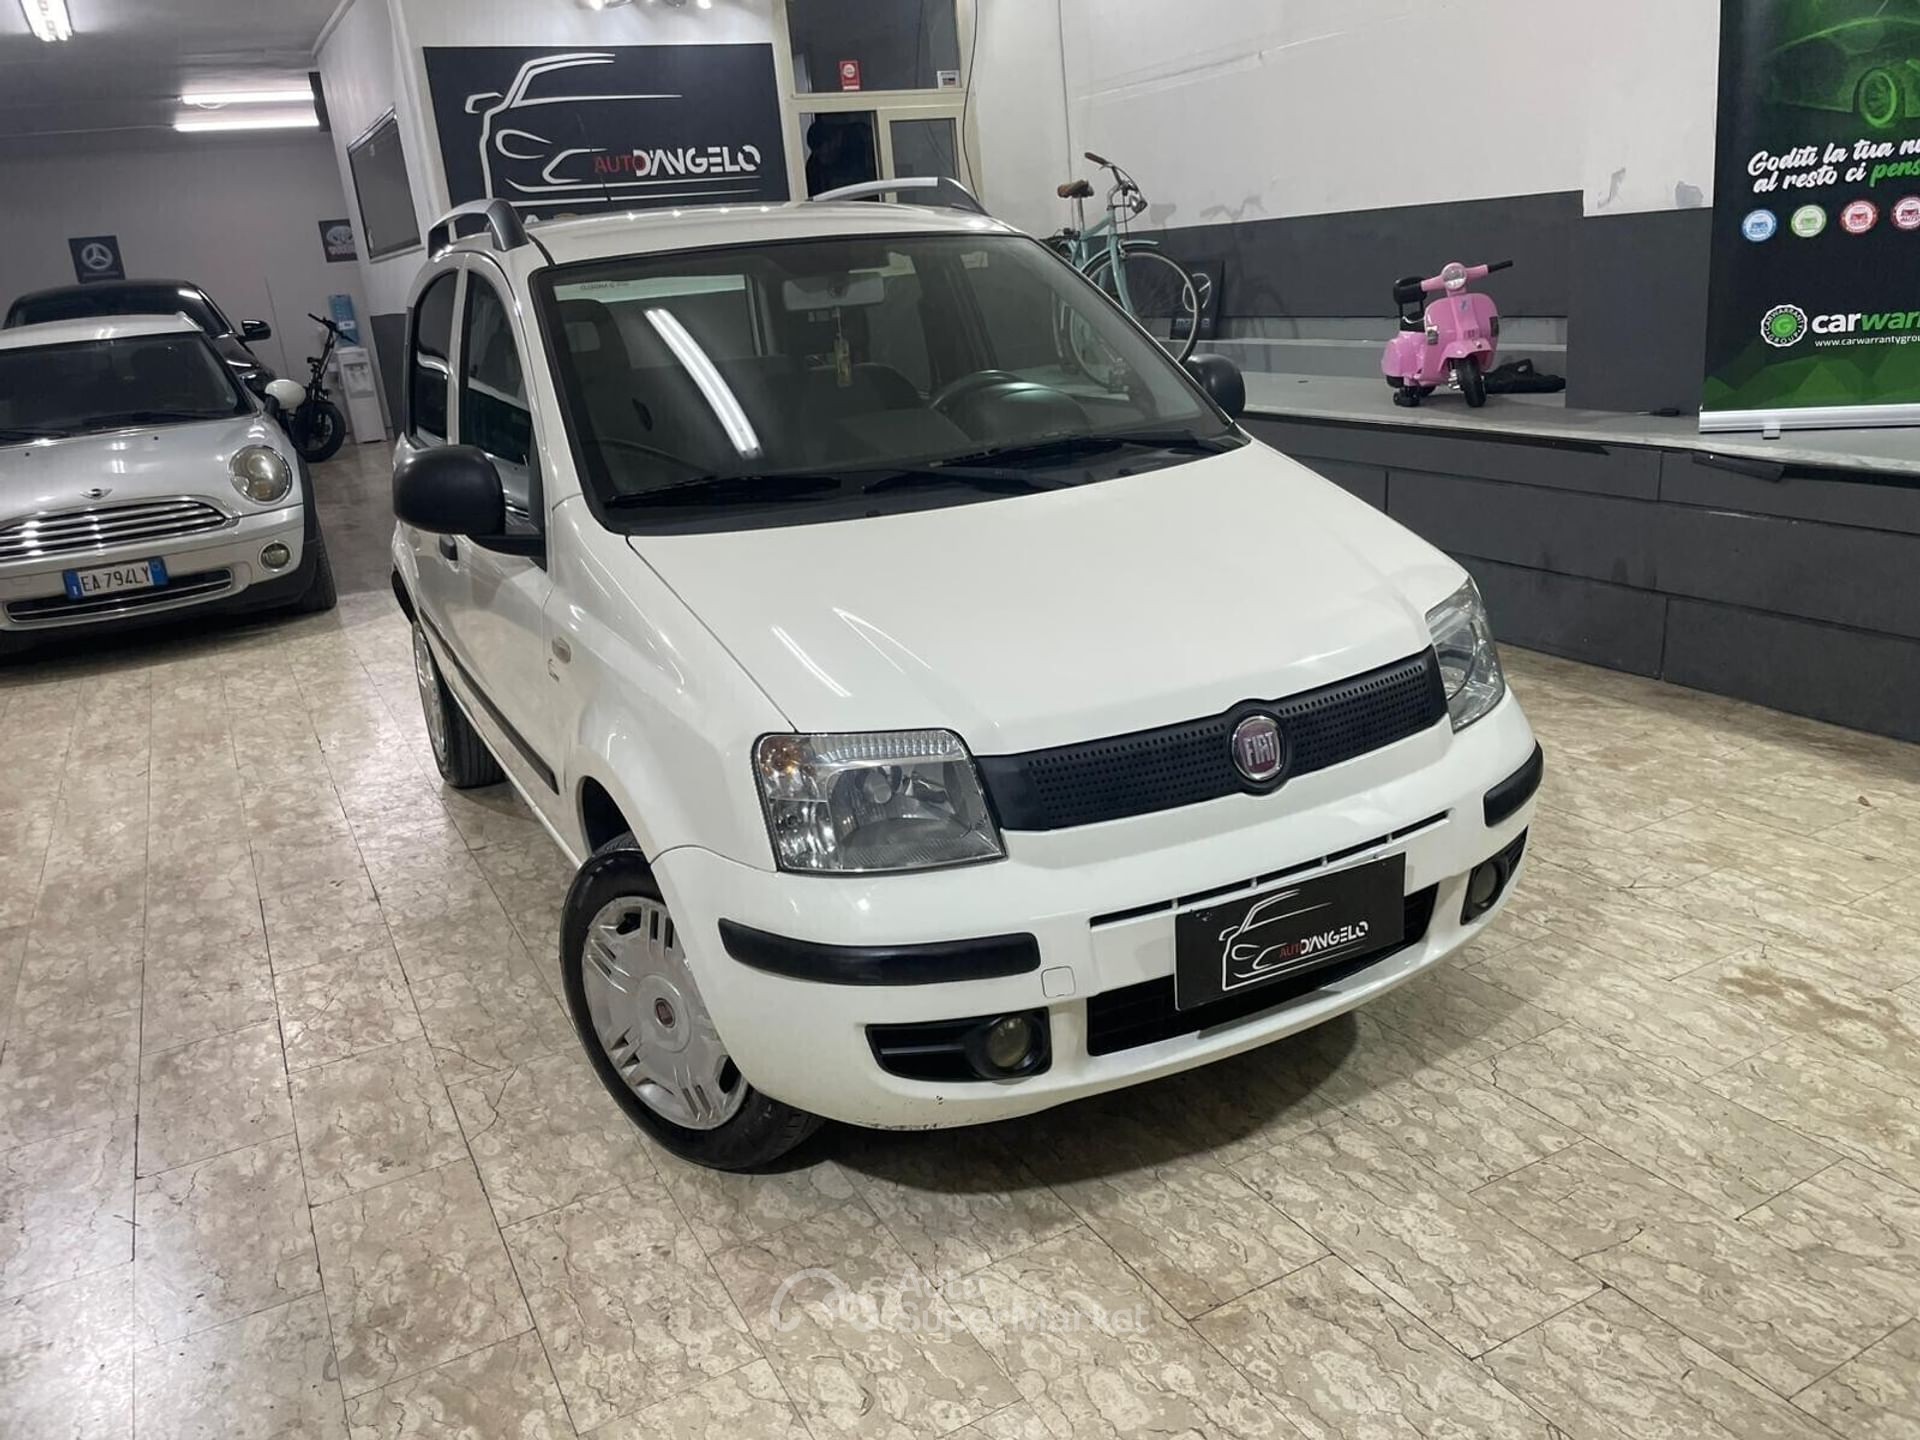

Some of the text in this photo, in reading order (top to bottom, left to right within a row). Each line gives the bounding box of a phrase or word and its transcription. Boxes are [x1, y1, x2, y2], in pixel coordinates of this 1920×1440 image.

[594, 154, 646, 174] AUTO
[1747, 145, 1818, 176] Goditi
[1823, 142, 1849, 164] la
[1853, 139, 1895, 160] tua
[1753, 170, 1779, 193] al
[1782, 165, 1838, 190] resto
[1844, 162, 1867, 182] ci
[1811, 311, 1920, 334] carwar
[80, 574, 101, 592] EA
[1243, 731, 1275, 767] FIAT
